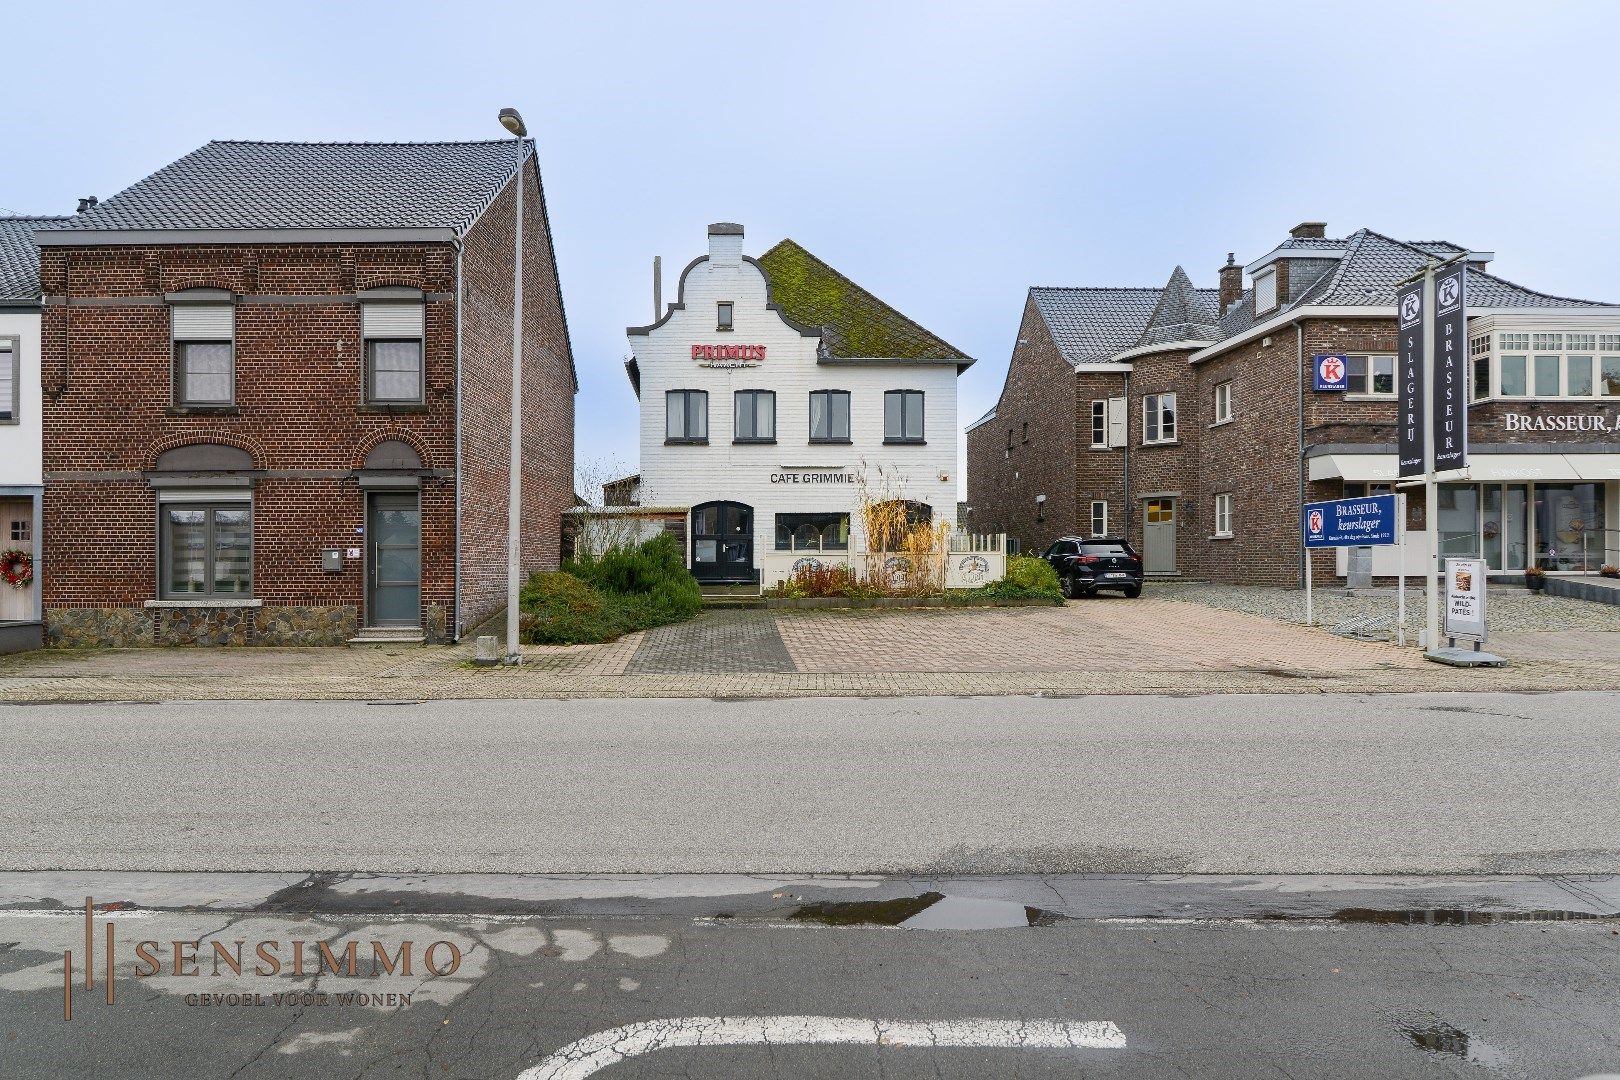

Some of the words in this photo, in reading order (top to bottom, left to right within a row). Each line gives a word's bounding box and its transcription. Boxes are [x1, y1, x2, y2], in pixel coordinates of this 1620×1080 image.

[691, 345, 767, 360] PRIMUS
[1324, 364, 1341, 380] K
[1407, 336, 1415, 442] SLAGERIJ
[1445, 323, 1453, 449] BRASSEUR
[1504, 413, 1612, 434] BRASSEUR,
[770, 473, 800, 484] CAFE
[802, 473, 855, 484] GRIMMIE
[1336, 502, 1382, 517] BRASSEUR,
[1337, 517, 1381, 532] keurslager
